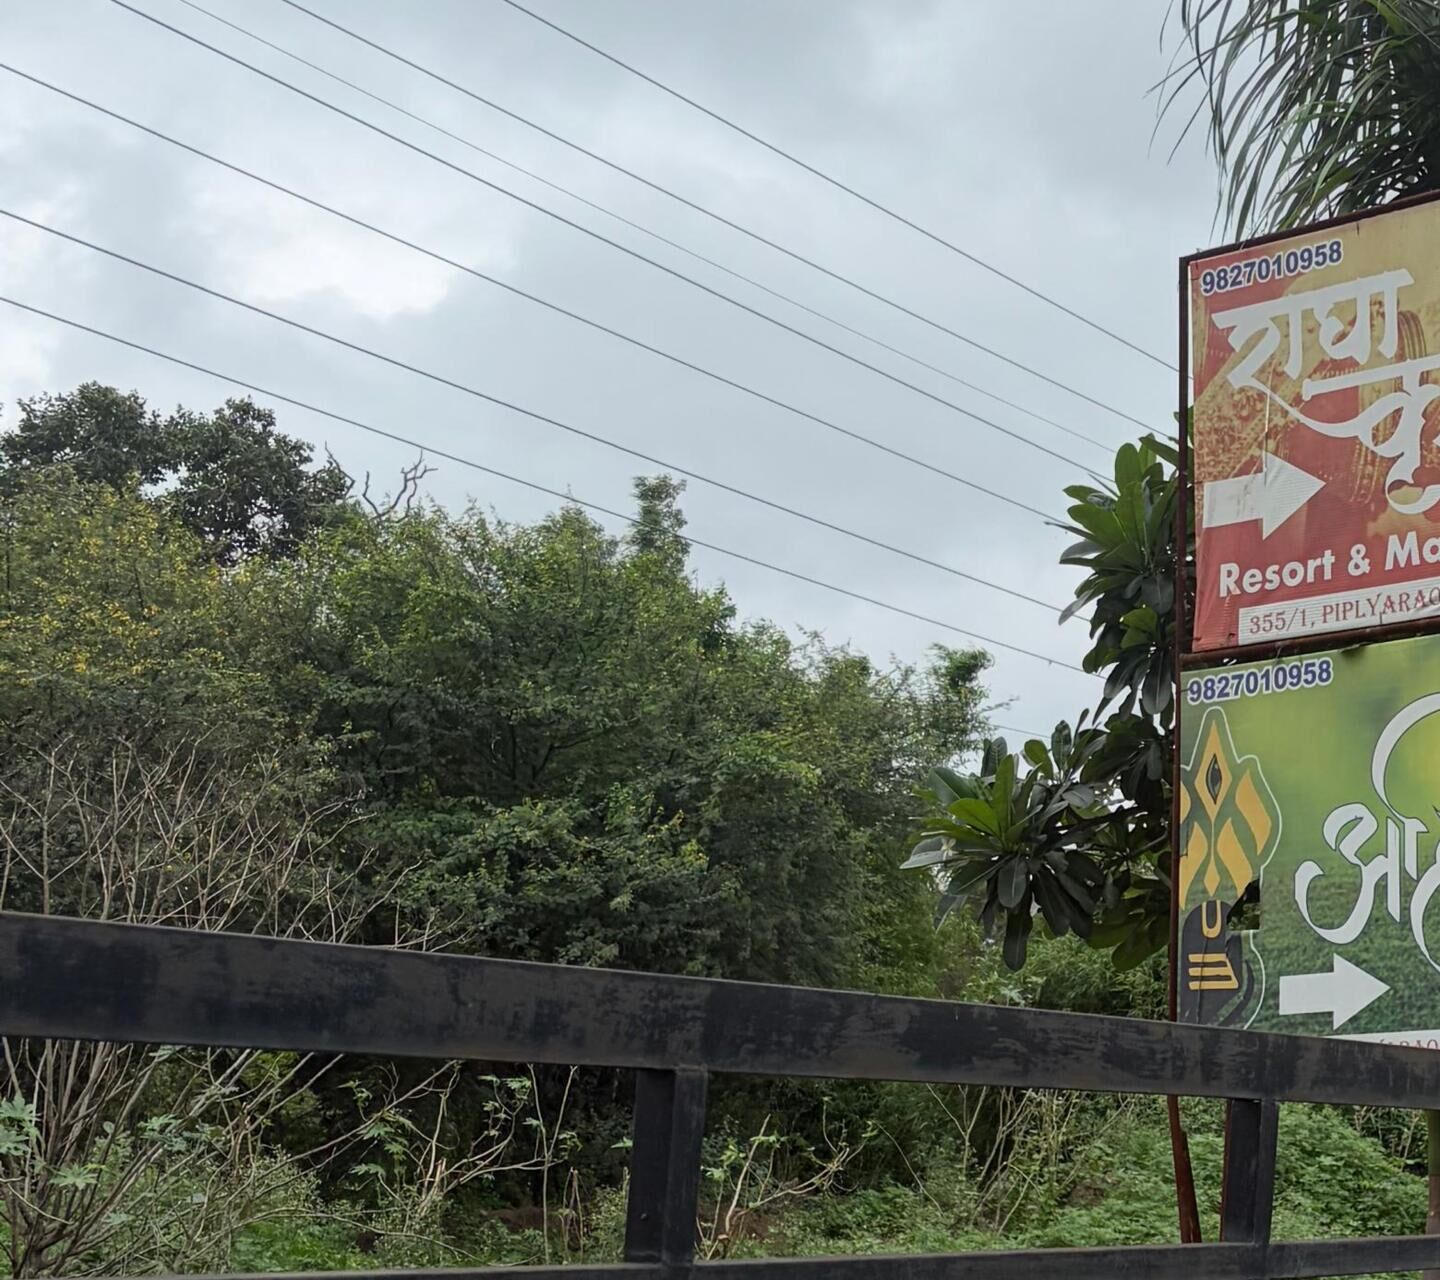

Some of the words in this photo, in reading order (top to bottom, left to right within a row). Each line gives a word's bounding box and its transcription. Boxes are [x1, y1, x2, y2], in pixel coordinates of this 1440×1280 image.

[1201, 239, 1343, 295] 9827010958
[1219, 549, 1335, 597] Resort
[1347, 543, 1370, 577] &
[1249, 606, 1315, 634] 355/1,
[1187, 657, 1334, 705] 9827010958
